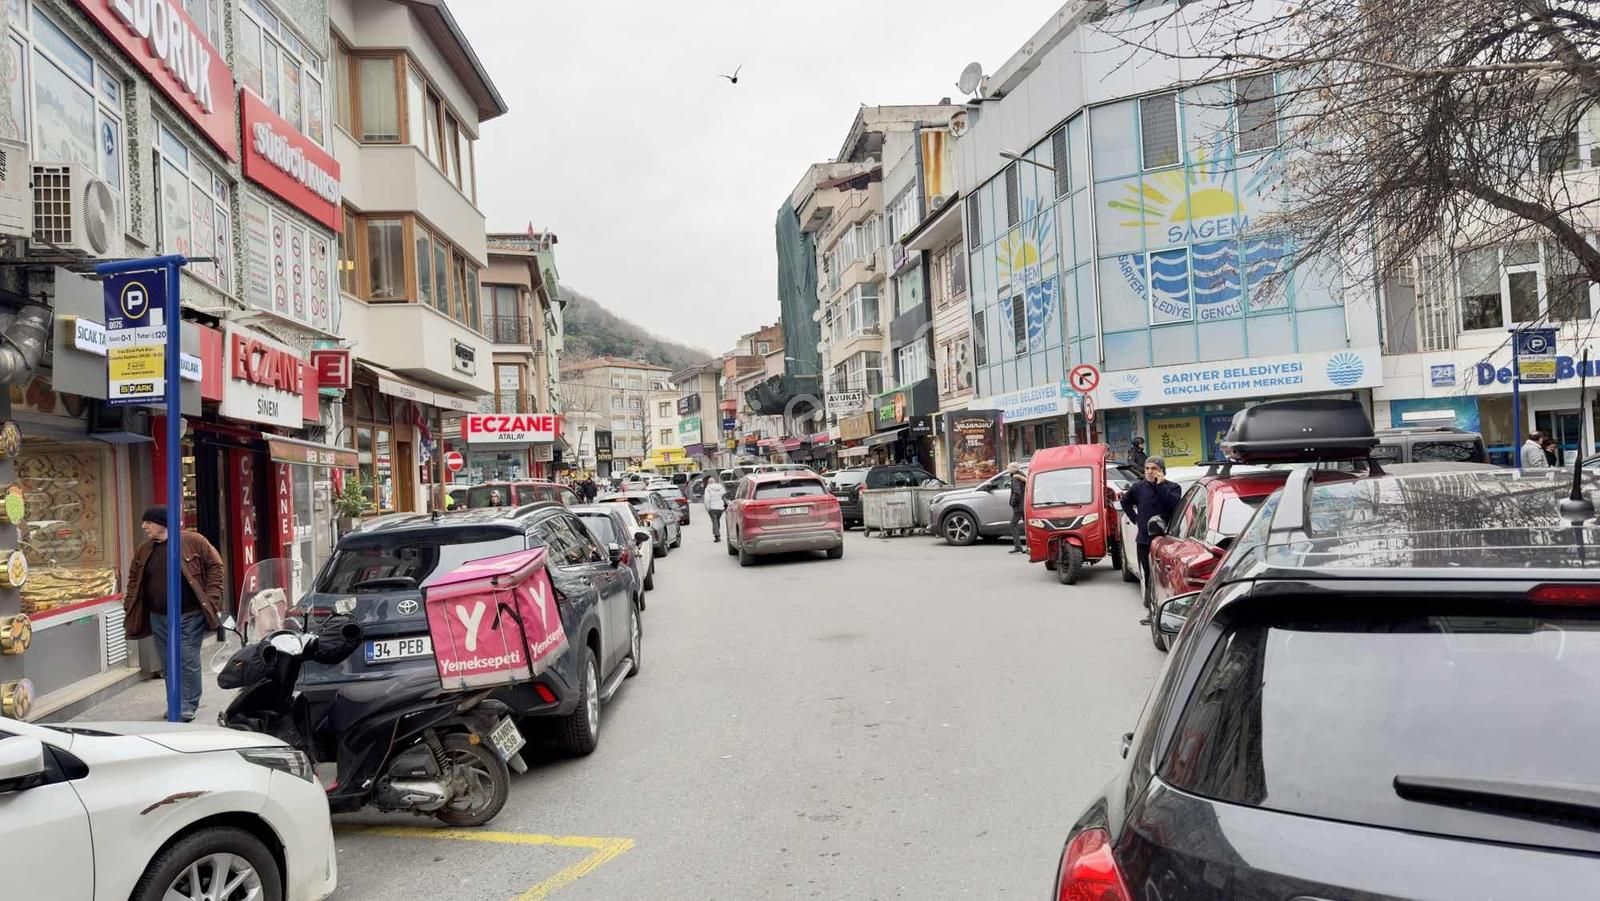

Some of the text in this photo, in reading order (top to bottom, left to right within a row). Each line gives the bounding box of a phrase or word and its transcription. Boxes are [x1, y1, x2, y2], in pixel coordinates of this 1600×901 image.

[1168, 215, 1249, 243] SAGEM
[127, 290, 143, 310] P
[77, 325, 97, 344] SICAK
[231, 332, 304, 396] ECZANE
[1163, 362, 1303, 385] SARIYER BELEDİYESİ
[1164, 376, 1303, 396] GENÇLİK EĞİTİM MERKEZİ
[257, 394, 279, 418] SİNEM
[829, 393, 861, 401] AVUKAT
[470, 416, 552, 433] ECZANE
[375, 643, 391, 658] 34
[400, 639, 424, 656] PEB
[440, 650, 520, 675] Yemeksepeti
